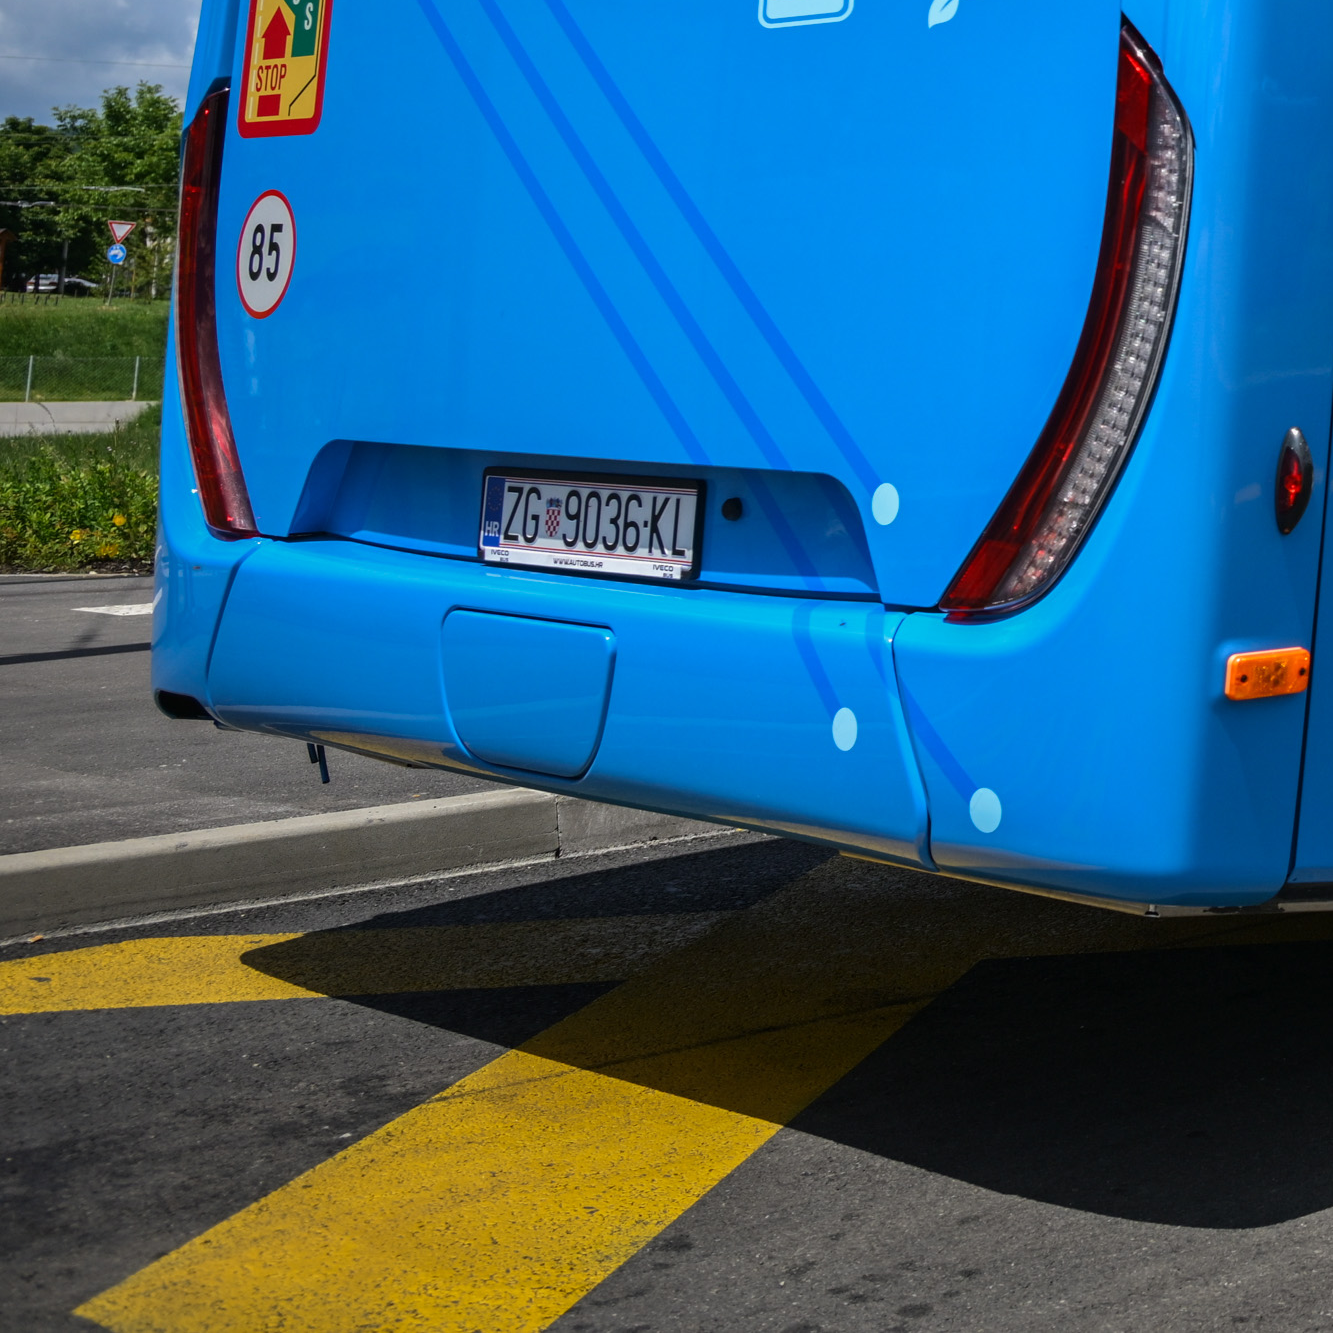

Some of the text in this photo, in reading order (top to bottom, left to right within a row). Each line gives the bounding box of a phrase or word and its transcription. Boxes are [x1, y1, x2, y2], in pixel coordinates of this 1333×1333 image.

[255, 63, 288, 93] STOP
[248, 222, 284, 283] 85
[503, 485, 542, 544] ZG
[484, 521, 500, 538] HR
[490, 549, 510, 557] IVECO
[652, 564, 674, 572] IVECO
